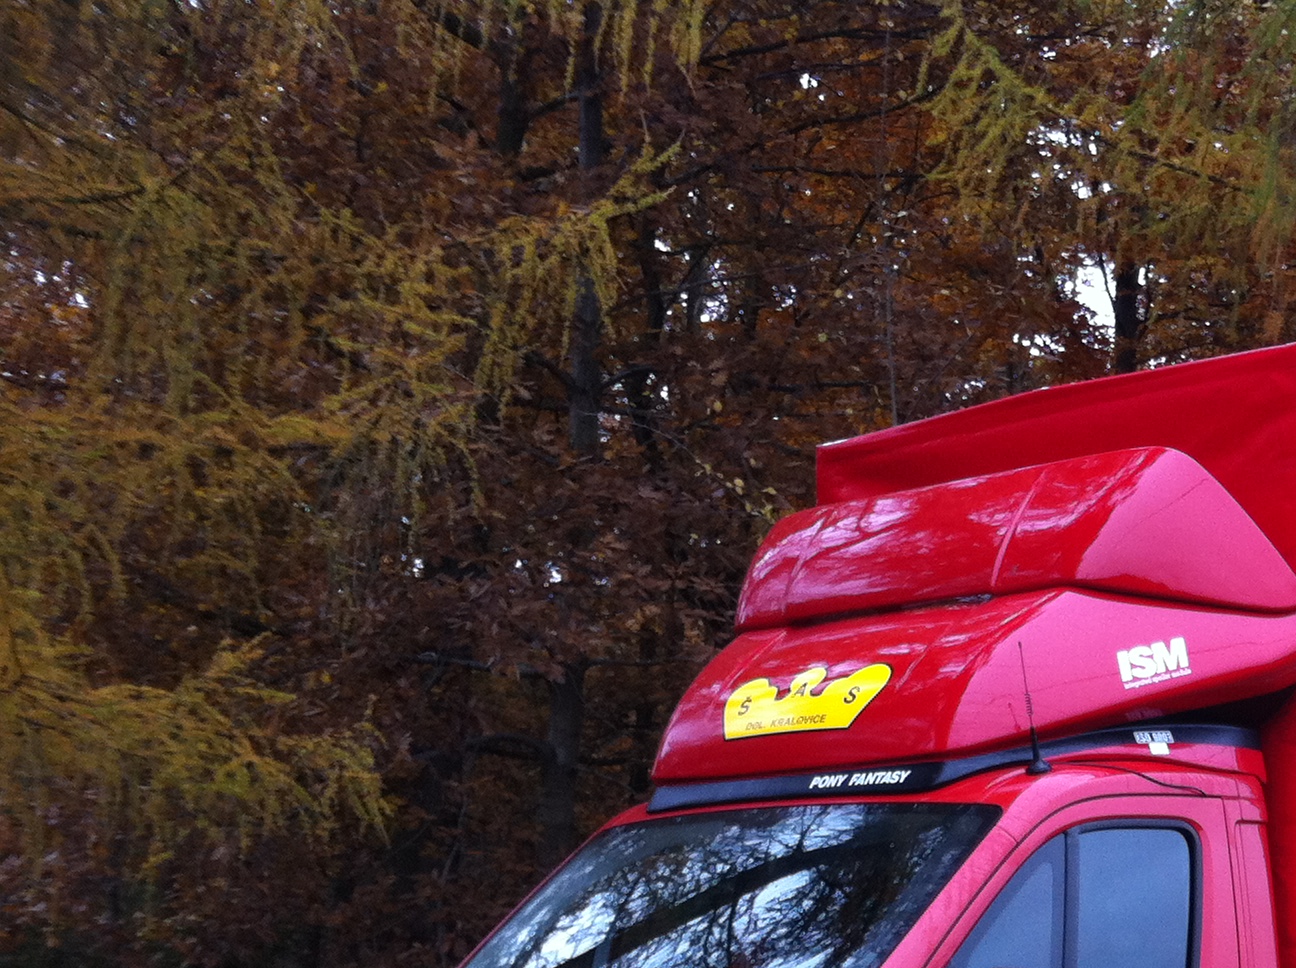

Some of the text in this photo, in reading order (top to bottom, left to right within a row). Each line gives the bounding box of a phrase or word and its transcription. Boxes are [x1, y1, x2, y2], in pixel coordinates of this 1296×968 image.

[1117, 637, 1189, 682] ISM
[809, 770, 912, 789] PONY FANTASY
